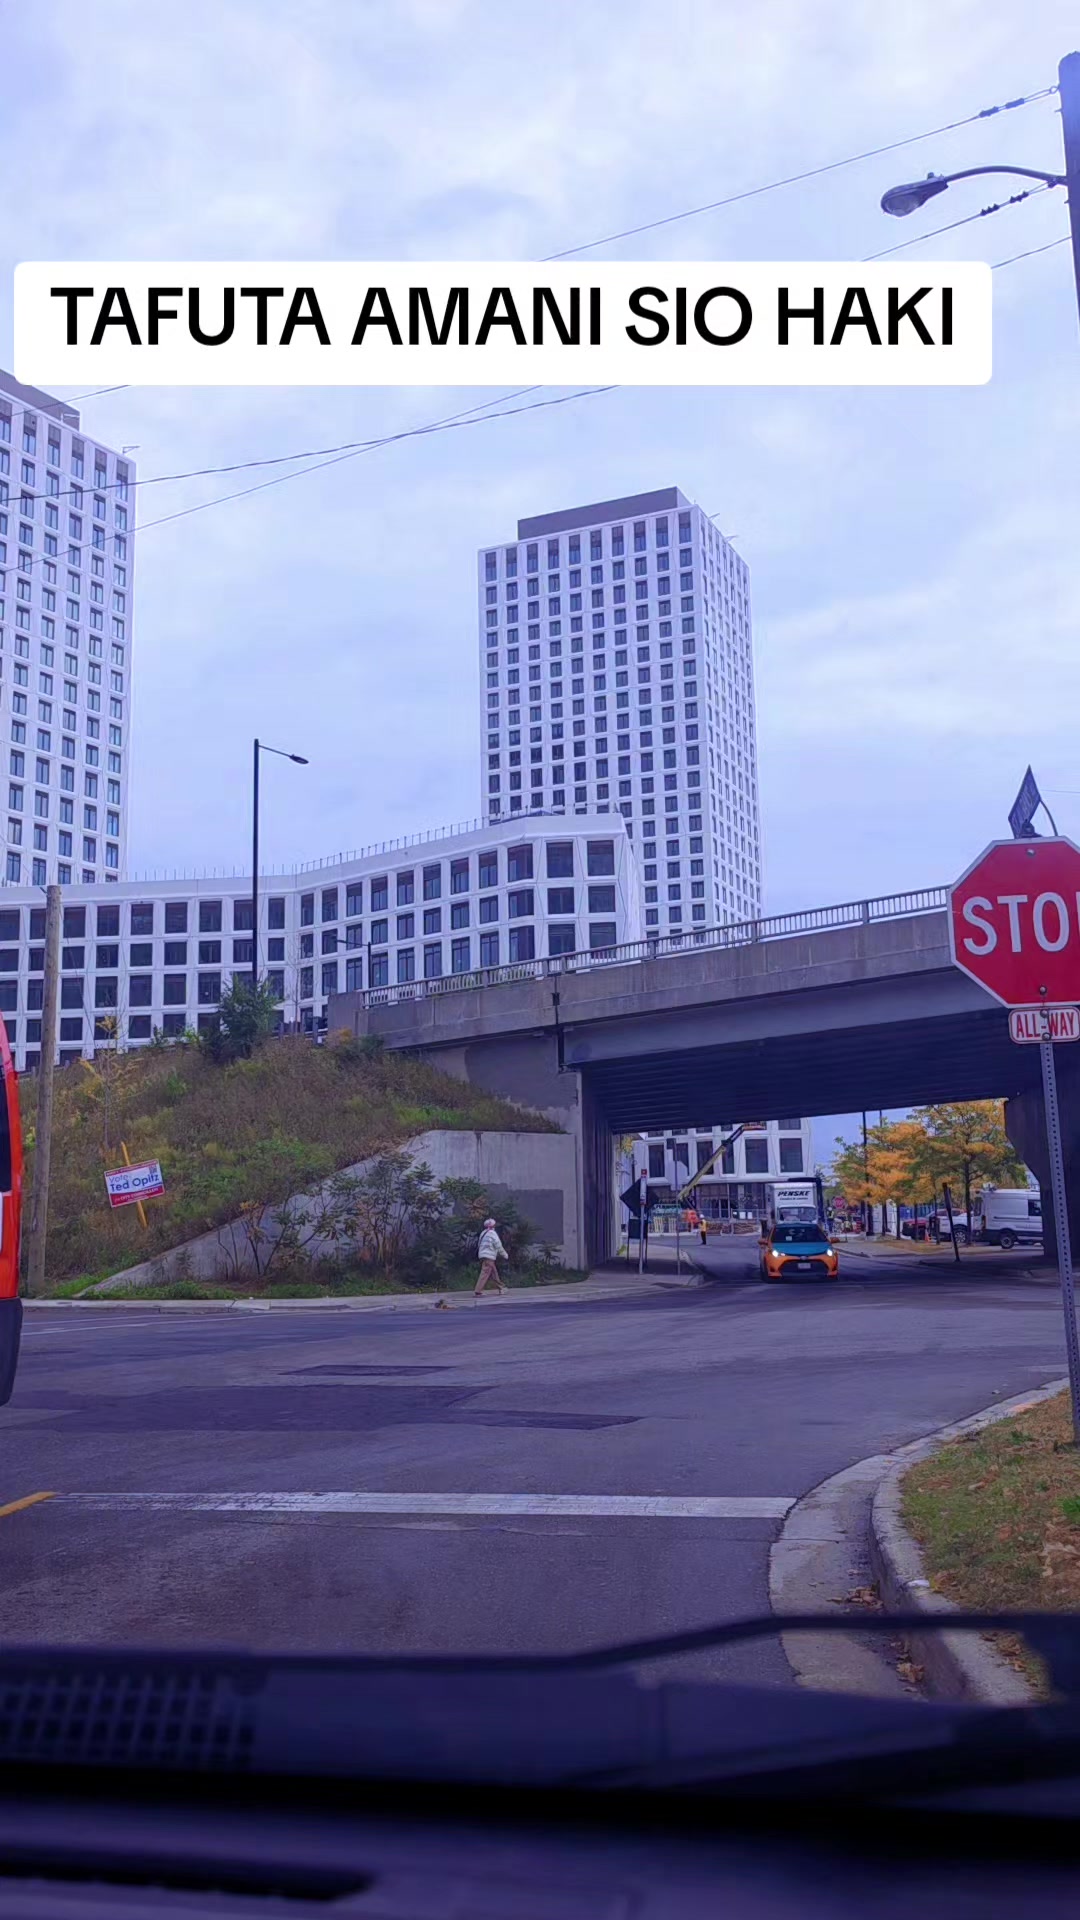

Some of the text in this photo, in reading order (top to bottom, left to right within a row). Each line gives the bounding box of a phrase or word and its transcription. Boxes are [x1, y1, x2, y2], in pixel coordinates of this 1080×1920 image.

[962, 891, 1080, 956] STO
[1016, 1012, 1074, 1038] ALL-WAY
[110, 1174, 159, 1192] Ted Opitz
